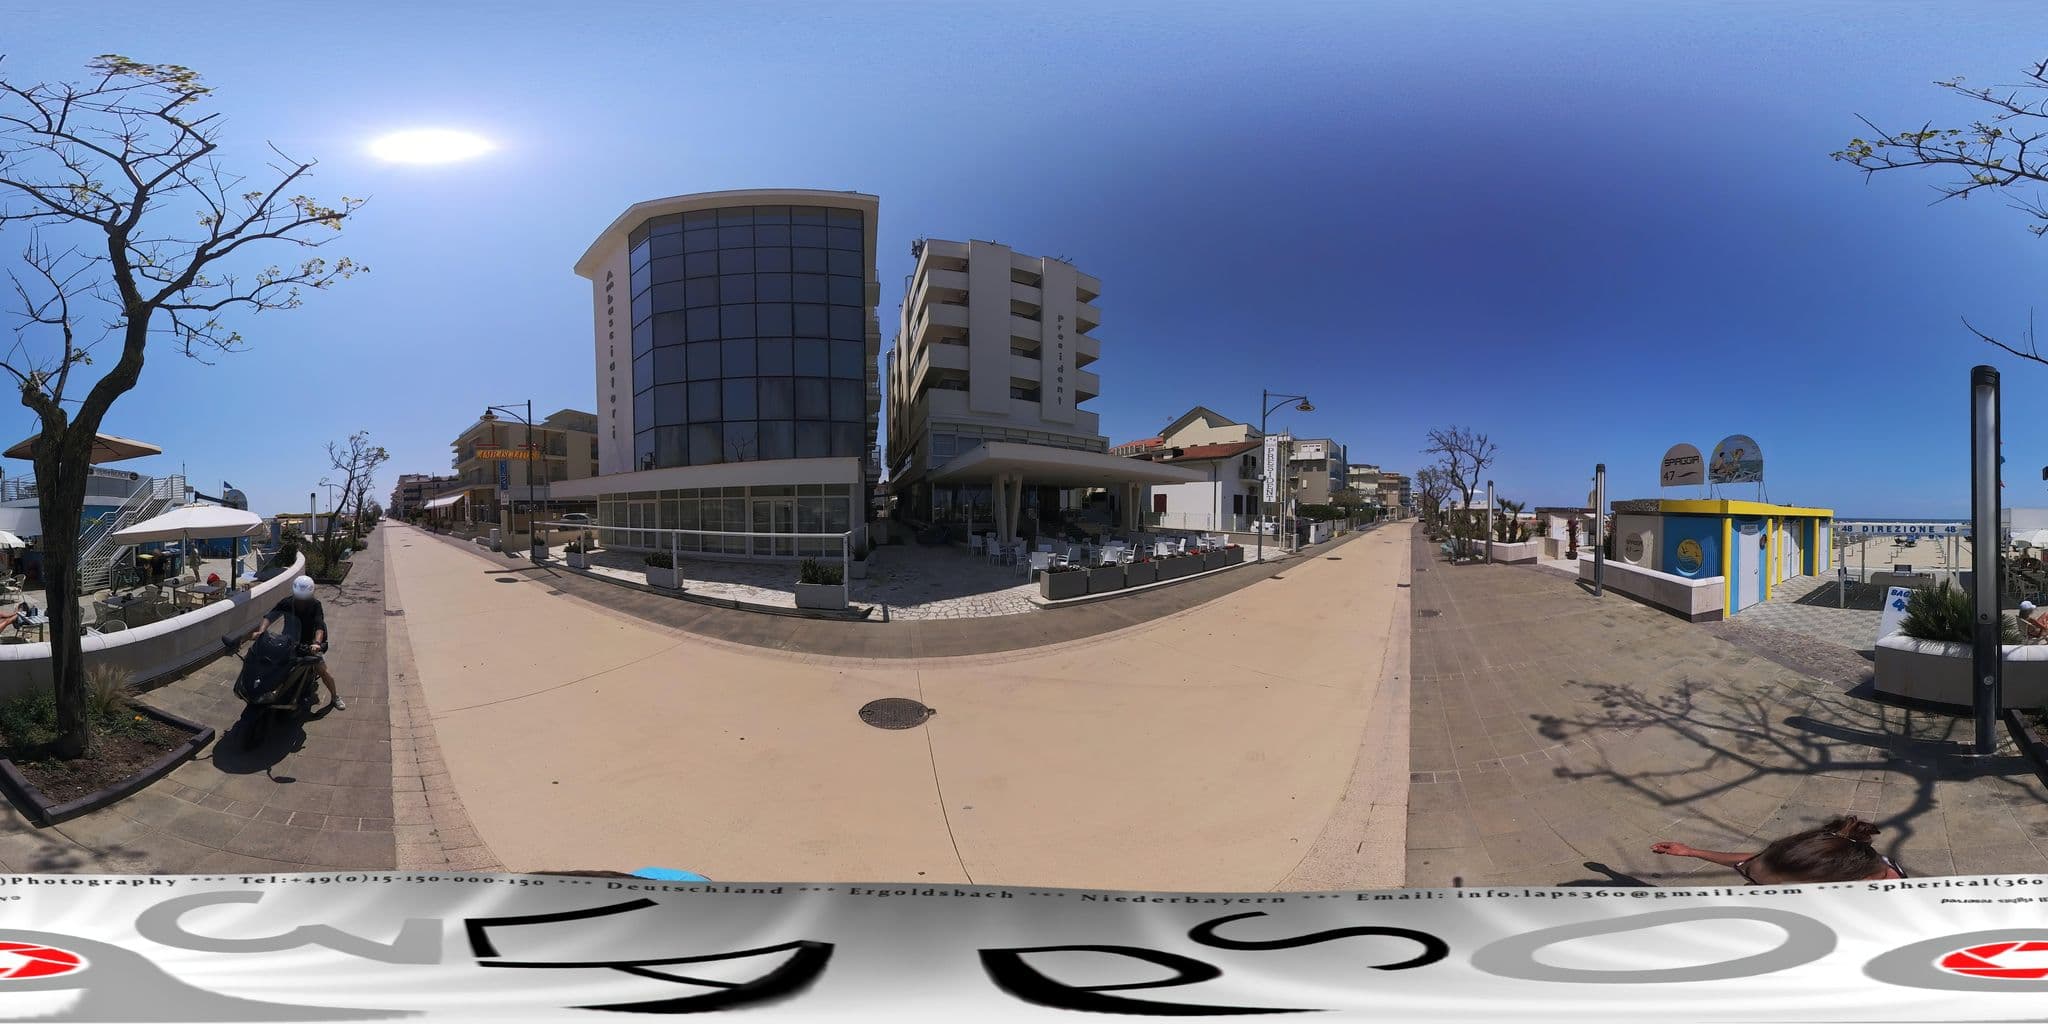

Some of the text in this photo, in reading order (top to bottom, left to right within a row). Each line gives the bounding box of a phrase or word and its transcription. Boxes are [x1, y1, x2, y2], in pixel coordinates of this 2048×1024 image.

[1663, 455, 1700, 467] SPIAGGIA
[1266, 447, 1275, 502] PRESIDENT
[1663, 470, 1676, 481] 47
[1862, 525, 1936, 533] DIREZIONE
[1891, 589, 1911, 597] BAG
[1892, 599, 1905, 611] 4
